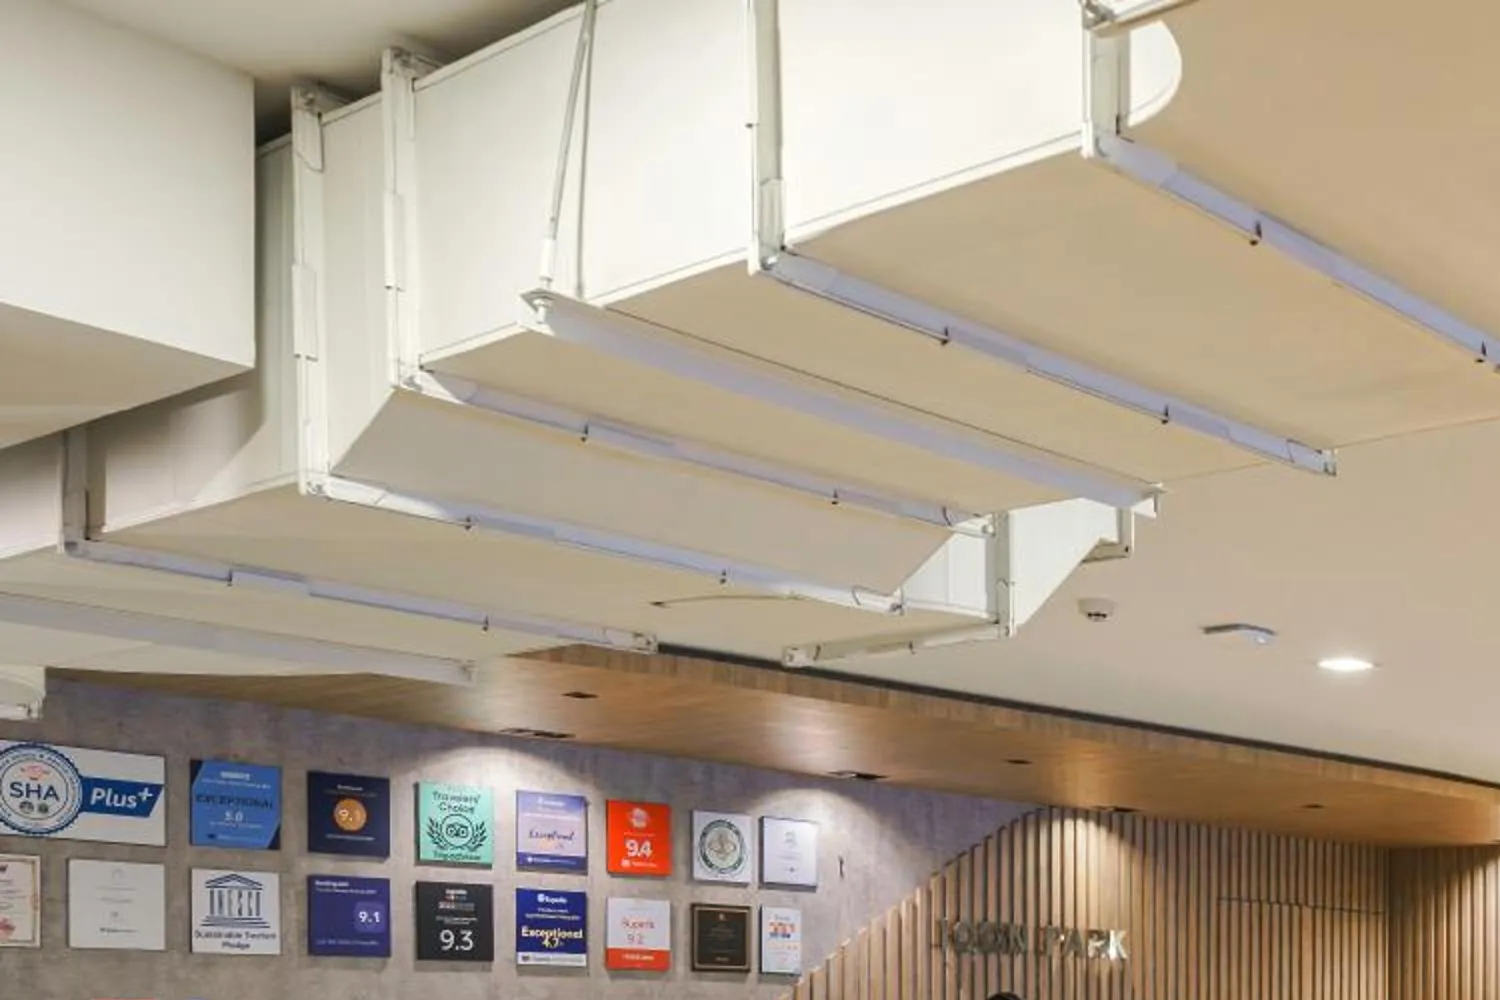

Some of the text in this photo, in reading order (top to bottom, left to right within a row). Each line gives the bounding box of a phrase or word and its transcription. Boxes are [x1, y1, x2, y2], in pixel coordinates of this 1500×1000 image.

[9, 781, 59, 801] SHA
[624, 839, 653, 858] 9.4
[358, 911, 380, 923] 9.1
[440, 929, 474, 951] 9.3
[1045, 926, 1128, 961] PARK
